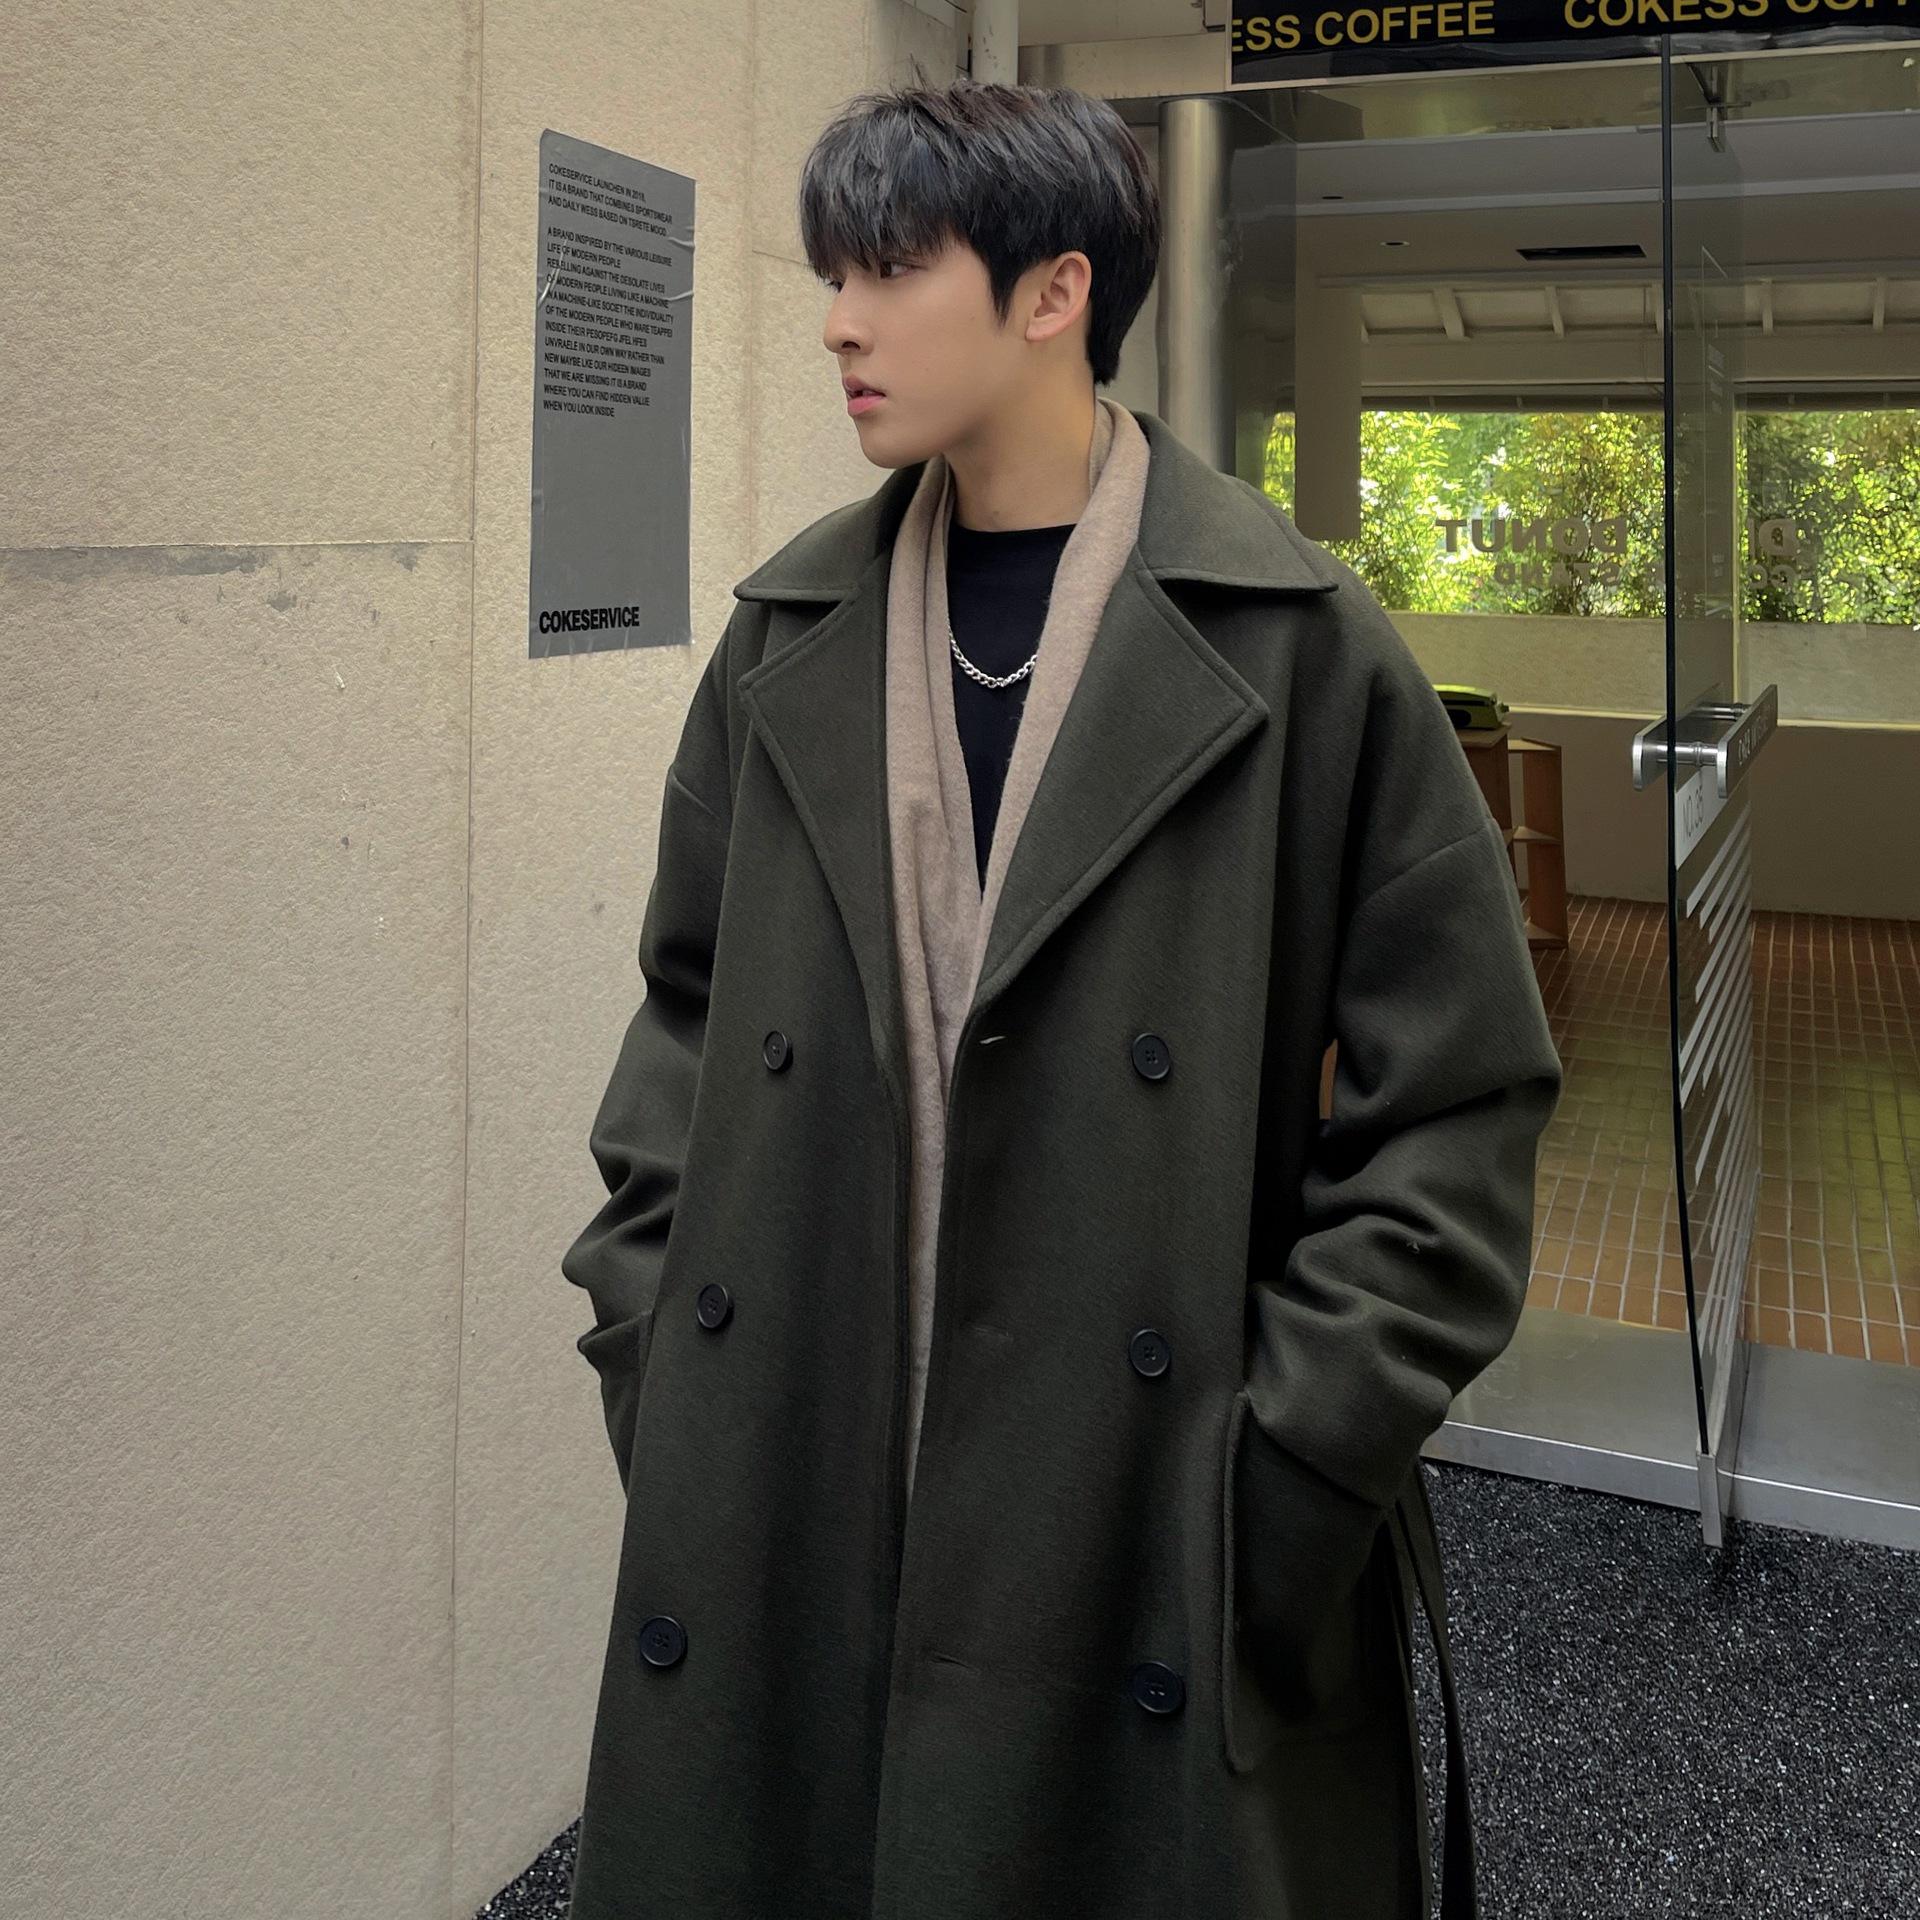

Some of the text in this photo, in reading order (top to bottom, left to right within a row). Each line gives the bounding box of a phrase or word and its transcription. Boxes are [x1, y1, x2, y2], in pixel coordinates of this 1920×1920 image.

[1315, 0, 1496, 46] COFFEE
[548, 194, 562, 207] AND
[562, 199, 580, 212] DAILY
[599, 209, 618, 223] BASED
[619, 214, 628, 225] ON
[549, 179, 672, 224] IT IS A BRAND THAT COMBINES SPORTSWEAR
[547, 226, 552, 236] A
[553, 227, 574, 242] BRAND
[575, 233, 603, 249] INSPIRED
[604, 240, 612, 252] BY
[612, 242, 623, 254] THE
[624, 245, 648, 261] VARIOUS
[547, 242, 621, 268] LIFE OF MODERN PEOPLE
[582, 265, 607, 280] AGAINST
[607, 271, 619, 283] THE
[557, 275, 583, 290] MODERN
[584, 281, 607, 295] PEOPLE
[608, 286, 626, 299] LIVING
[628, 290, 640, 302] LIKE
[640, 293, 644, 303] A
[645, 294, 669, 308] MACHINE
[546, 304, 554, 315] OF
[555, 306, 568, 318] THE
[569, 309, 594, 323] MODERN
[596, 314, 619, 328] PEOPLE
[620, 318, 632, 330] WHO
[554, 291, 559, 300] A
[636, 307, 673, 324] INDIVIDUALITY
[546, 320, 566, 333] INSIDE
[568, 324, 585, 336] THEIR
[544, 352, 559, 363] NEW
[560, 354, 581, 366] MAYBE
[594, 359, 607, 370] OUR
[579, 341, 585, 352] IN
[586, 343, 599, 354] OUR
[600, 345, 614, 356] OWN
[615, 347, 627, 358] WAY
[628, 350, 650, 362] RATHER
[651, 353, 664, 364] THAN
[544, 367, 560, 379] THAT
[561, 370, 570, 380] WE
[572, 371, 584, 382] ARE
[585, 373, 609, 386] MISSING
[610, 377, 616, 387] IT
[627, 379, 647, 391] BRAND
[544, 383, 650, 406] WHERE YOU CAN FIND HIDDEN VALUE
[543, 399, 615, 417] WHEN YOU LOOK INSIDE
[539, 606, 640, 634] COKESERVICE
